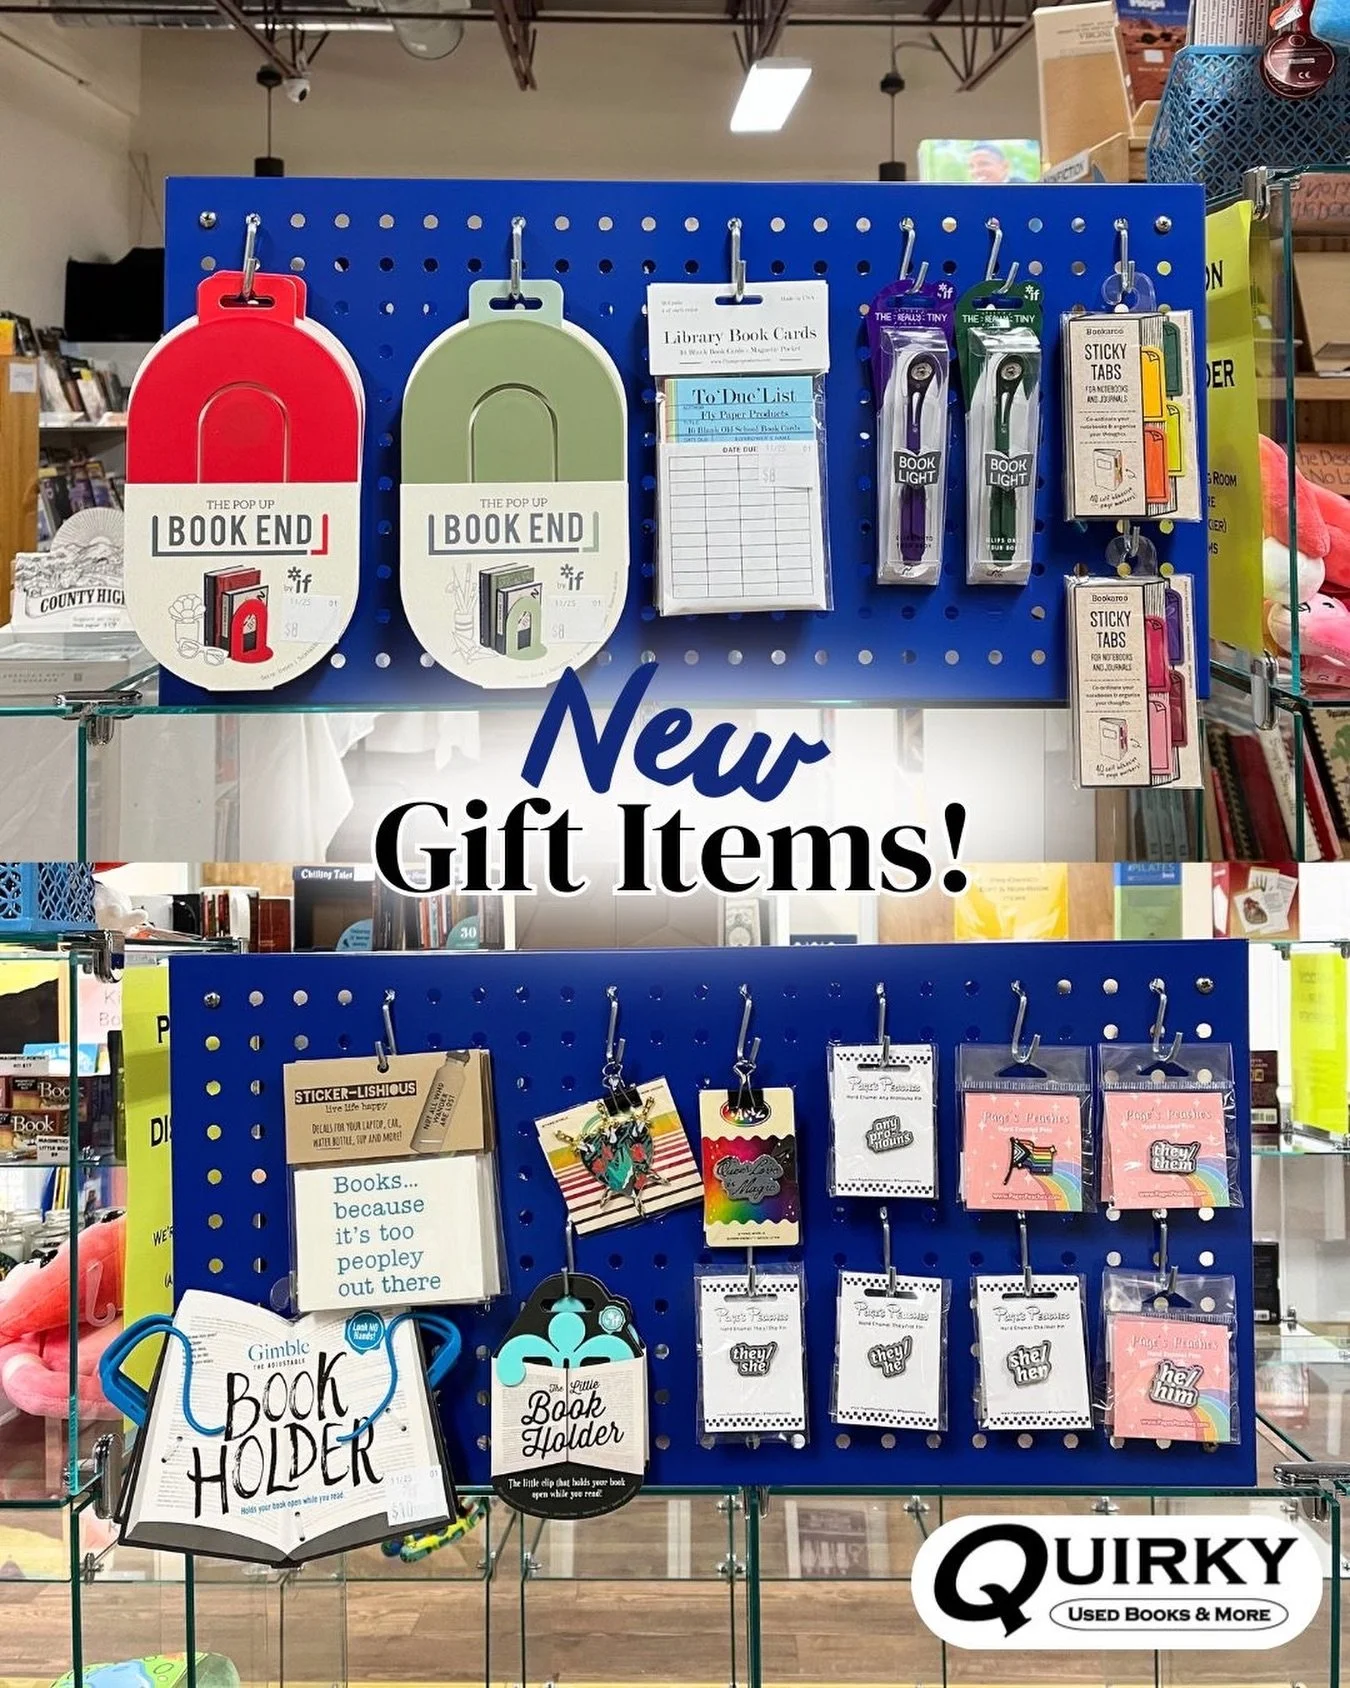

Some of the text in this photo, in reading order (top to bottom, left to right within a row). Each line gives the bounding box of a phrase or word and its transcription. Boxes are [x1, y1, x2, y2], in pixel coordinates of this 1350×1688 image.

[875, 313, 892, 321] THE
[926, 313, 948, 322] TINY
[962, 314, 1035, 323] THE TINY
[664, 326, 818, 346] Library Book Cards
[1086, 328, 1124, 336] Bookaroo
[1084, 343, 1127, 361] STICKY
[1090, 364, 1122, 381] TABS
[692, 388, 716, 404] To
[763, 387, 797, 403] List
[1085, 384, 1129, 393] FOR NOTEBOOKS
[1087, 395, 1129, 403] AND JOURNALS
[701, 409, 789, 421] Fly Paper Products
[899, 456, 936, 470] BOOK
[990, 459, 1028, 472] BOOK
[898, 470, 937, 484] LIGHT
[989, 473, 1028, 487] LIGHT
[206, 500, 275, 510] THE POP UP
[480, 498, 549, 508] THE POP UP
[169, 514, 312, 546] BOOK END
[445, 512, 583, 544] BOOK END
[40, 588, 96, 613] COUNTY
[1091, 594, 1129, 603] Bookaroo
[1090, 610, 1132, 628] STICKY
[285, 622, 299, 638] $8
[1096, 631, 1127, 648] TABS
[1091, 653, 1133, 661] FOR NOTEBOOKS
[301, 868, 333, 880] Chilling
[460, 926, 477, 938] 30
[295, 1082, 416, 1103] STICKER-LISHIOUS
[325, 1102, 388, 1113] live life happy
[423, 1082, 445, 1130] NOT ALL WHO
[433, 1093, 449, 1124] WANDER
[440, 1094, 455, 1127] ARE LOST
[982, 1111, 1070, 1125] Page's Peaches
[1125, 1108, 1212, 1122] Page's Peaches
[13, 1115, 54, 1132] Book
[150, 1115, 171, 1147] DI
[312, 1123, 333, 1134] DECALS
[334, 1122, 345, 1132] FOR
[346, 1121, 361, 1131] YOUR
[362, 1119, 386, 1130] LAPTOP,
[875, 1118, 898, 1130] any
[313, 1137, 331, 1147] WATER
[368, 1133, 382, 1143] AND
[869, 1129, 896, 1144] pro-
[874, 1133, 911, 1149] nouns
[1154, 1142, 1196, 1161] they/
[1154, 1157, 1193, 1170] them
[333, 1173, 418, 1194] Books...
[333, 1199, 425, 1219] because
[336, 1224, 414, 1245] it's too
[337, 1249, 424, 1275] peopley
[338, 1275, 441, 1297] out there
[352, 1322, 379, 1331] Look NO
[353, 1331, 376, 1340] Hands!
[248, 1339, 310, 1362] Gimble
[733, 1346, 773, 1362] they/
[871, 1340, 909, 1363] they/
[1010, 1343, 1047, 1367] she/
[253, 1358, 306, 1371] THE ADJUSTABLE
[741, 1361, 767, 1372] she
[884, 1360, 902, 1374] he
[1017, 1363, 1048, 1382] her
[1160, 1363, 1200, 1387] he/
[549, 1380, 600, 1394] The Little
[1153, 1381, 1195, 1405] him
[224, 1351, 349, 1442] BOOK
[521, 1390, 606, 1425] Book
[521, 1420, 625, 1459] Holder
[186, 1415, 385, 1518] HOLDER
[429, 1470, 439, 1478] 01
[508, 1477, 626, 1489] The little clip that holds your book
[532, 1490, 549, 1500] open
[550, 1489, 568, 1498] while
[569, 1490, 583, 1499] you
[240, 1506, 257, 1515] Holds
[258, 1504, 271, 1513] your
[272, 1502, 286, 1510] book
[287, 1499, 302, 1508] open
[303, 1496, 318, 1504] while
[319, 1494, 330, 1503] you
[391, 1501, 414, 1519] $10
